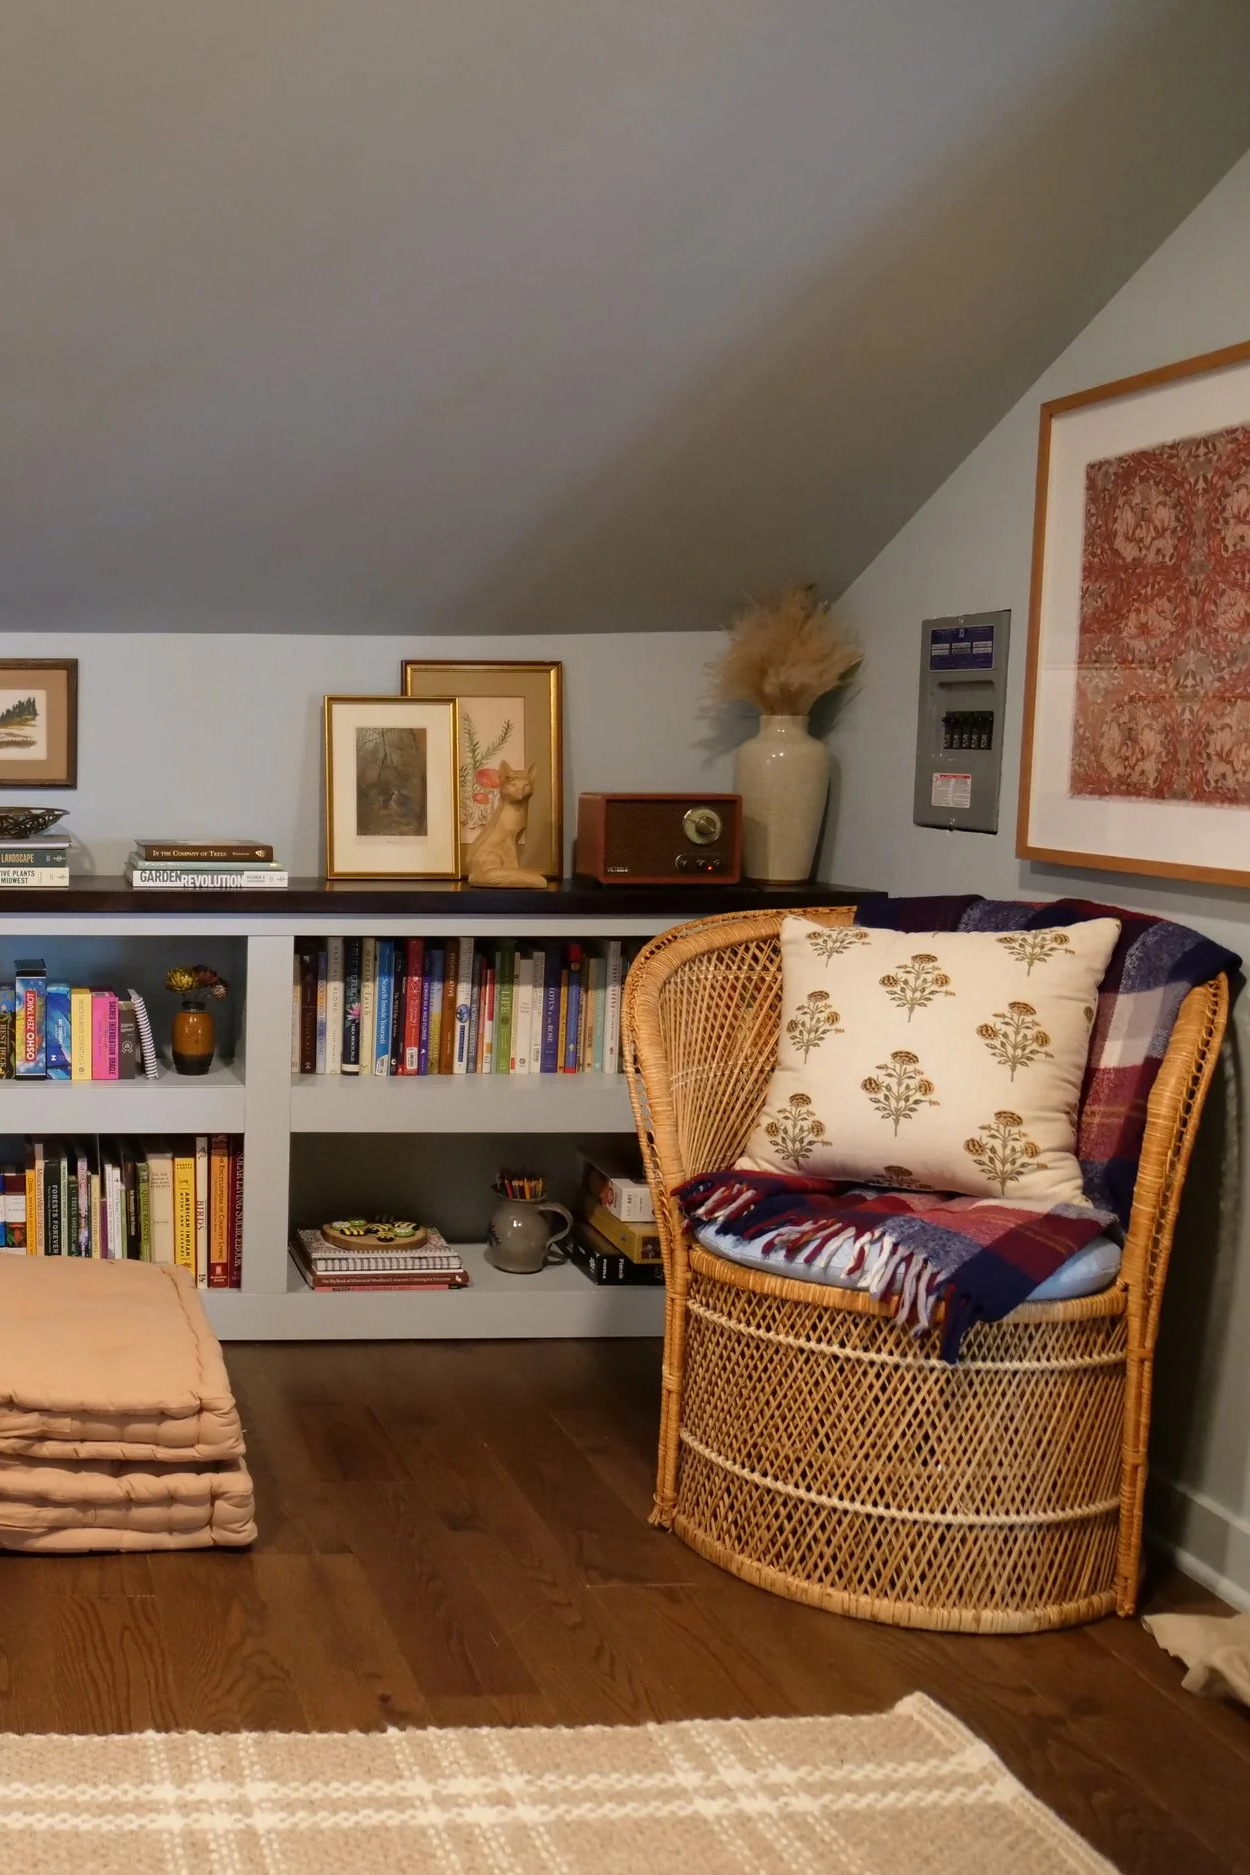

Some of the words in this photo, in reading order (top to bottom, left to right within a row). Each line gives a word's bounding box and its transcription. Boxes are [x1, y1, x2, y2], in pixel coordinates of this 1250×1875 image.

[1, 853, 34, 862] LANDSCAPE
[139, 870, 182, 883] GARDEN
[181, 874, 244, 887] REVOLUTION
[26, 992, 35, 1016] TAROT
[108, 1001, 117, 1020] SACRED
[364, 991, 373, 1016] faith
[501, 991, 510, 1014] LIFE
[0, 1024, 7, 1045] REST
[26, 1015, 35, 1031] ZEN
[379, 1019, 388, 1045] Yourself
[546, 1025, 554, 1043] ROSE
[0, 1046, 7, 1069] DECK
[26, 1032, 35, 1060] OSHO
[108, 1056, 117, 1075] ORACLE
[236, 1151, 244, 1180] SOLAR
[235, 1180, 243, 1209] LIVING
[142, 1213, 150, 1241] BEAUTY
[197, 1200, 205, 1231] BIRDS
[234, 1209, 243, 1267] SOURCEBOOK
